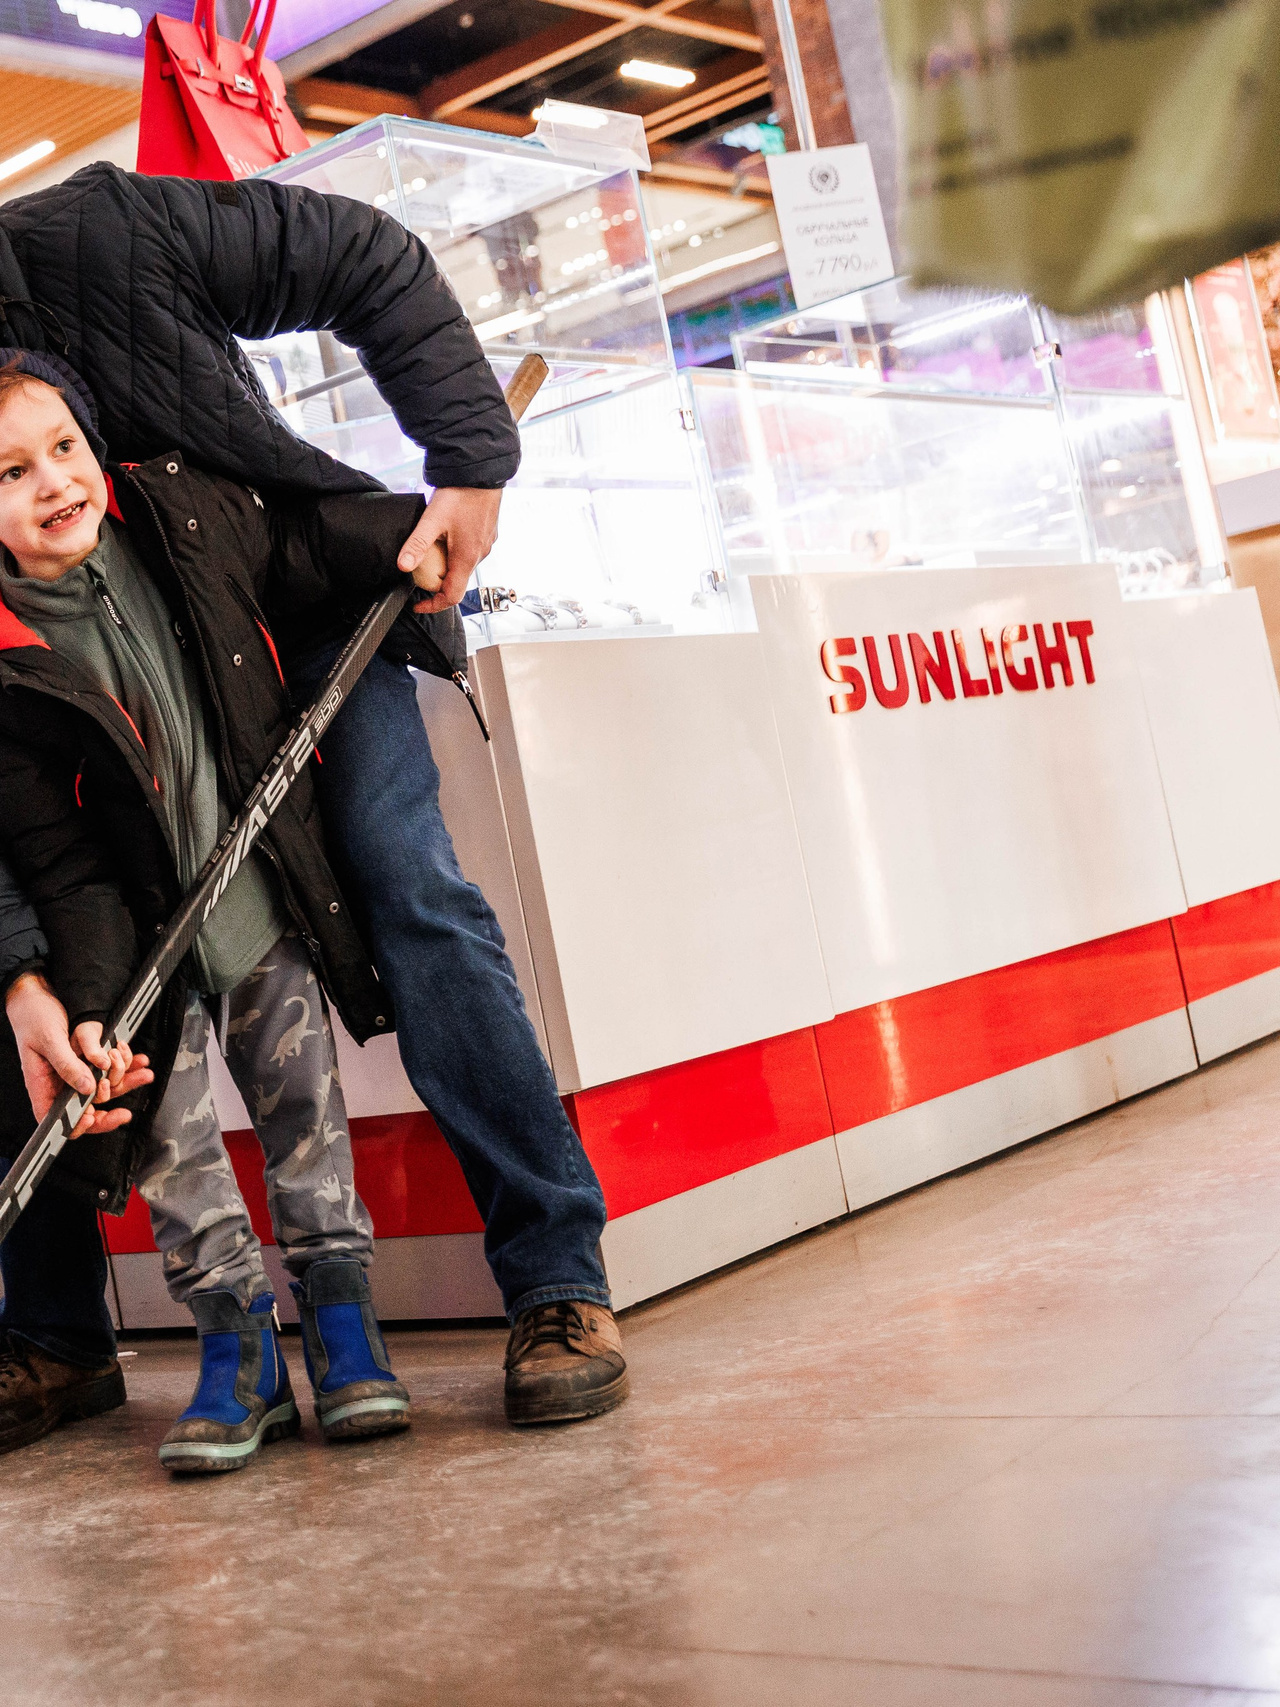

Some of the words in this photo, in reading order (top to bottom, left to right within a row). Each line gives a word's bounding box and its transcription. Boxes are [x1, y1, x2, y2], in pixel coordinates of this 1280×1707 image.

[816, 253, 862, 276] 7790
[820, 619, 1096, 714] SUNLIGHT
[241, 726, 314, 861] A5.2
[244, 703, 316, 809] TRUE
